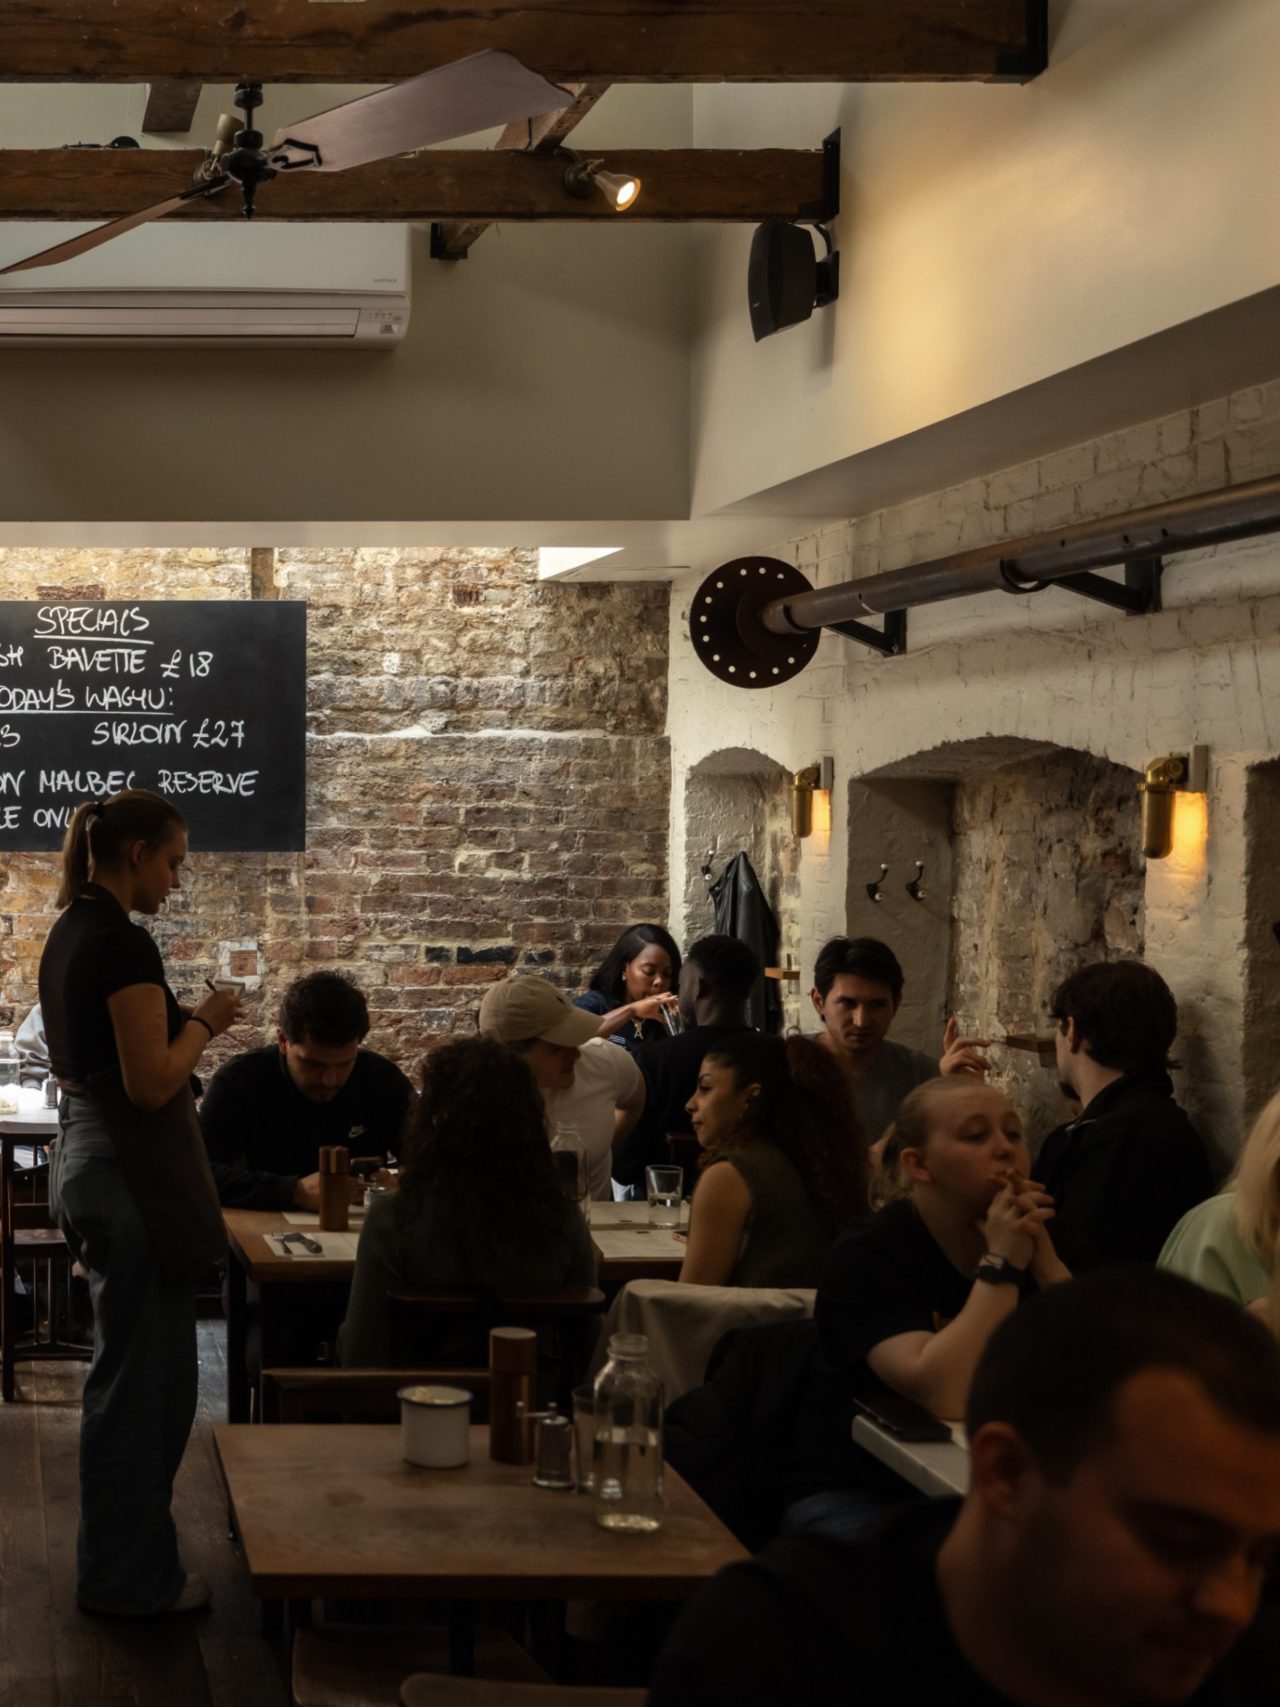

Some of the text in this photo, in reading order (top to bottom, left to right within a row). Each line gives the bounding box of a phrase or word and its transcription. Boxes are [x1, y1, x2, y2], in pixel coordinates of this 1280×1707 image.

[33, 604, 150, 636] SPECIALS
[47, 646, 147, 674] BAVETTE
[85, 686, 174, 710] WAGYU:
[91, 719, 188, 746] SIRLOIN
[192, 718, 245, 749] £27
[39, 769, 136, 796] MALBEC
[158, 769, 259, 797] RESERVE
[33, 806, 77, 830] ONL
